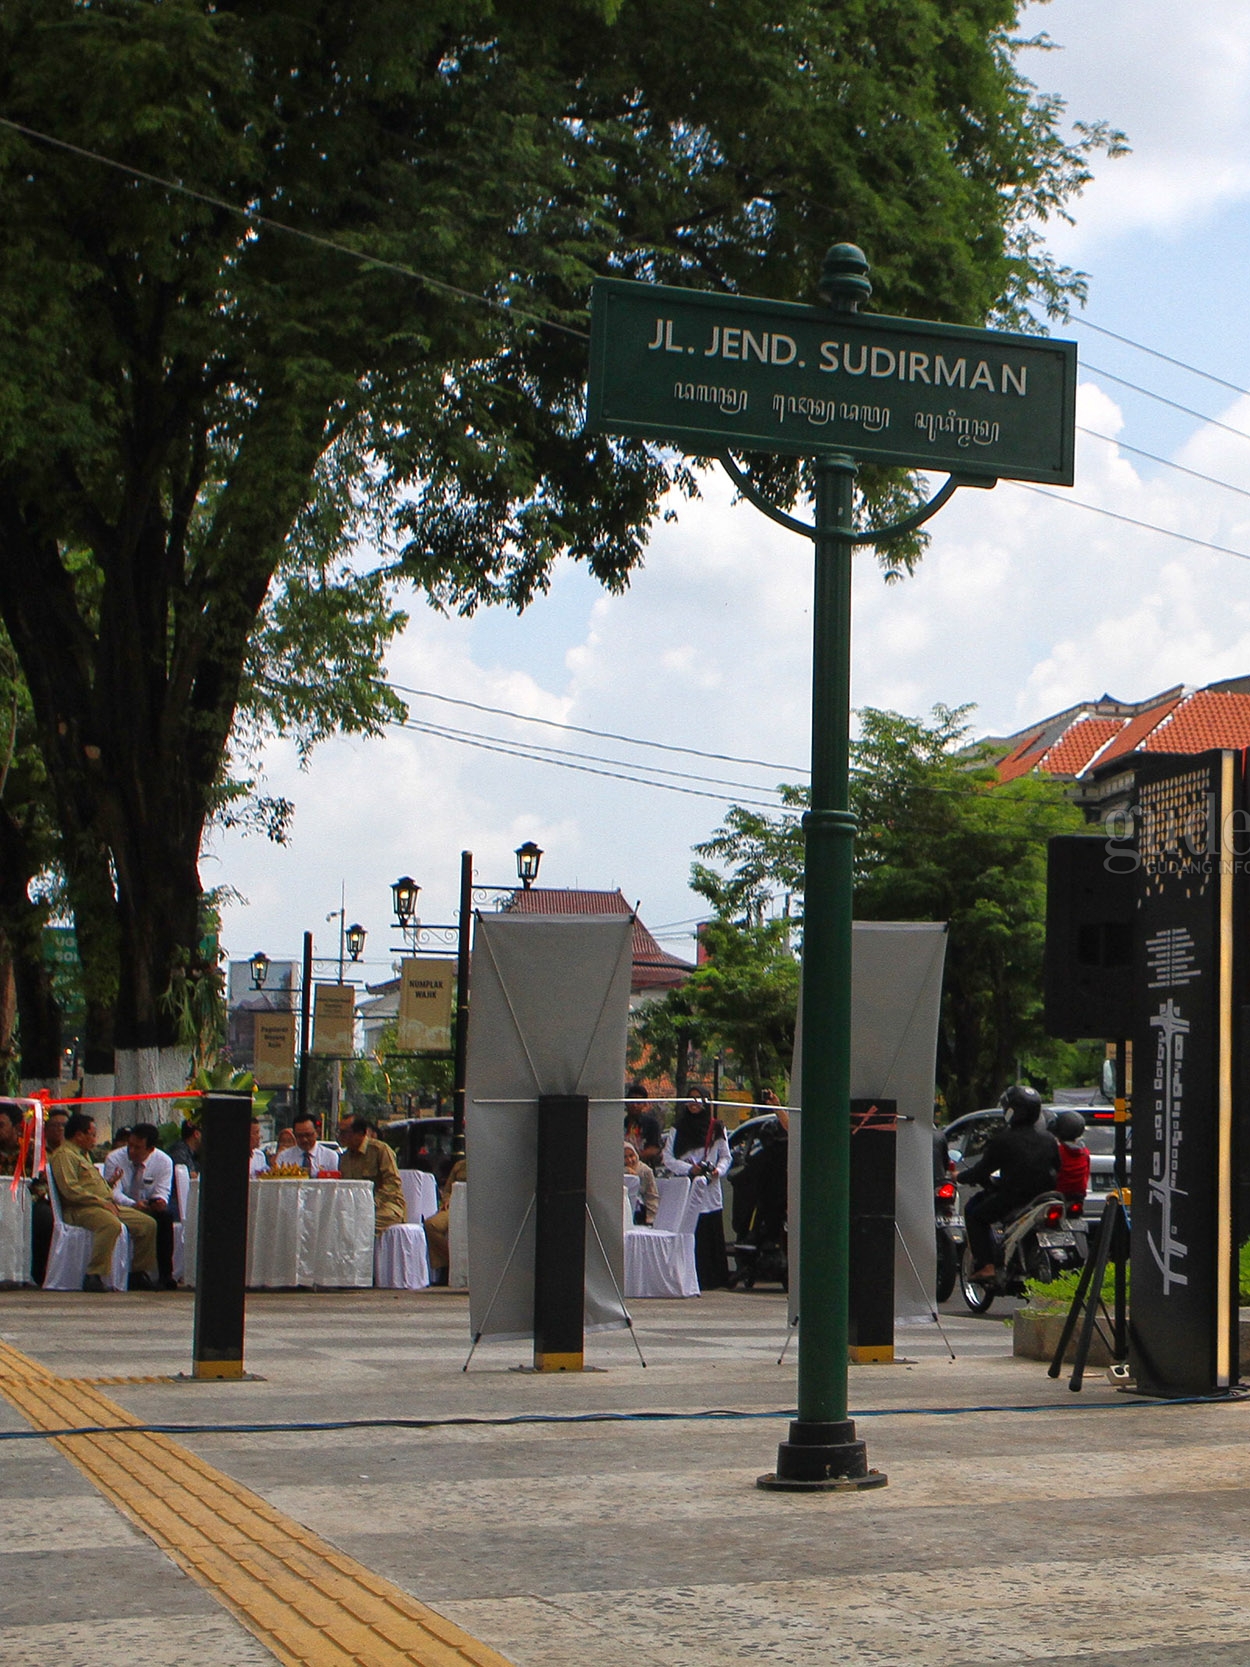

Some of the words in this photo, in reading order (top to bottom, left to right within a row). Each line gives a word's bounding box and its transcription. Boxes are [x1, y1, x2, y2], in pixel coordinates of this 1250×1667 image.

[648, 318, 695, 354] JL.
[704, 326, 806, 368] JEND.
[819, 341, 1027, 396] SUDIRMAN
